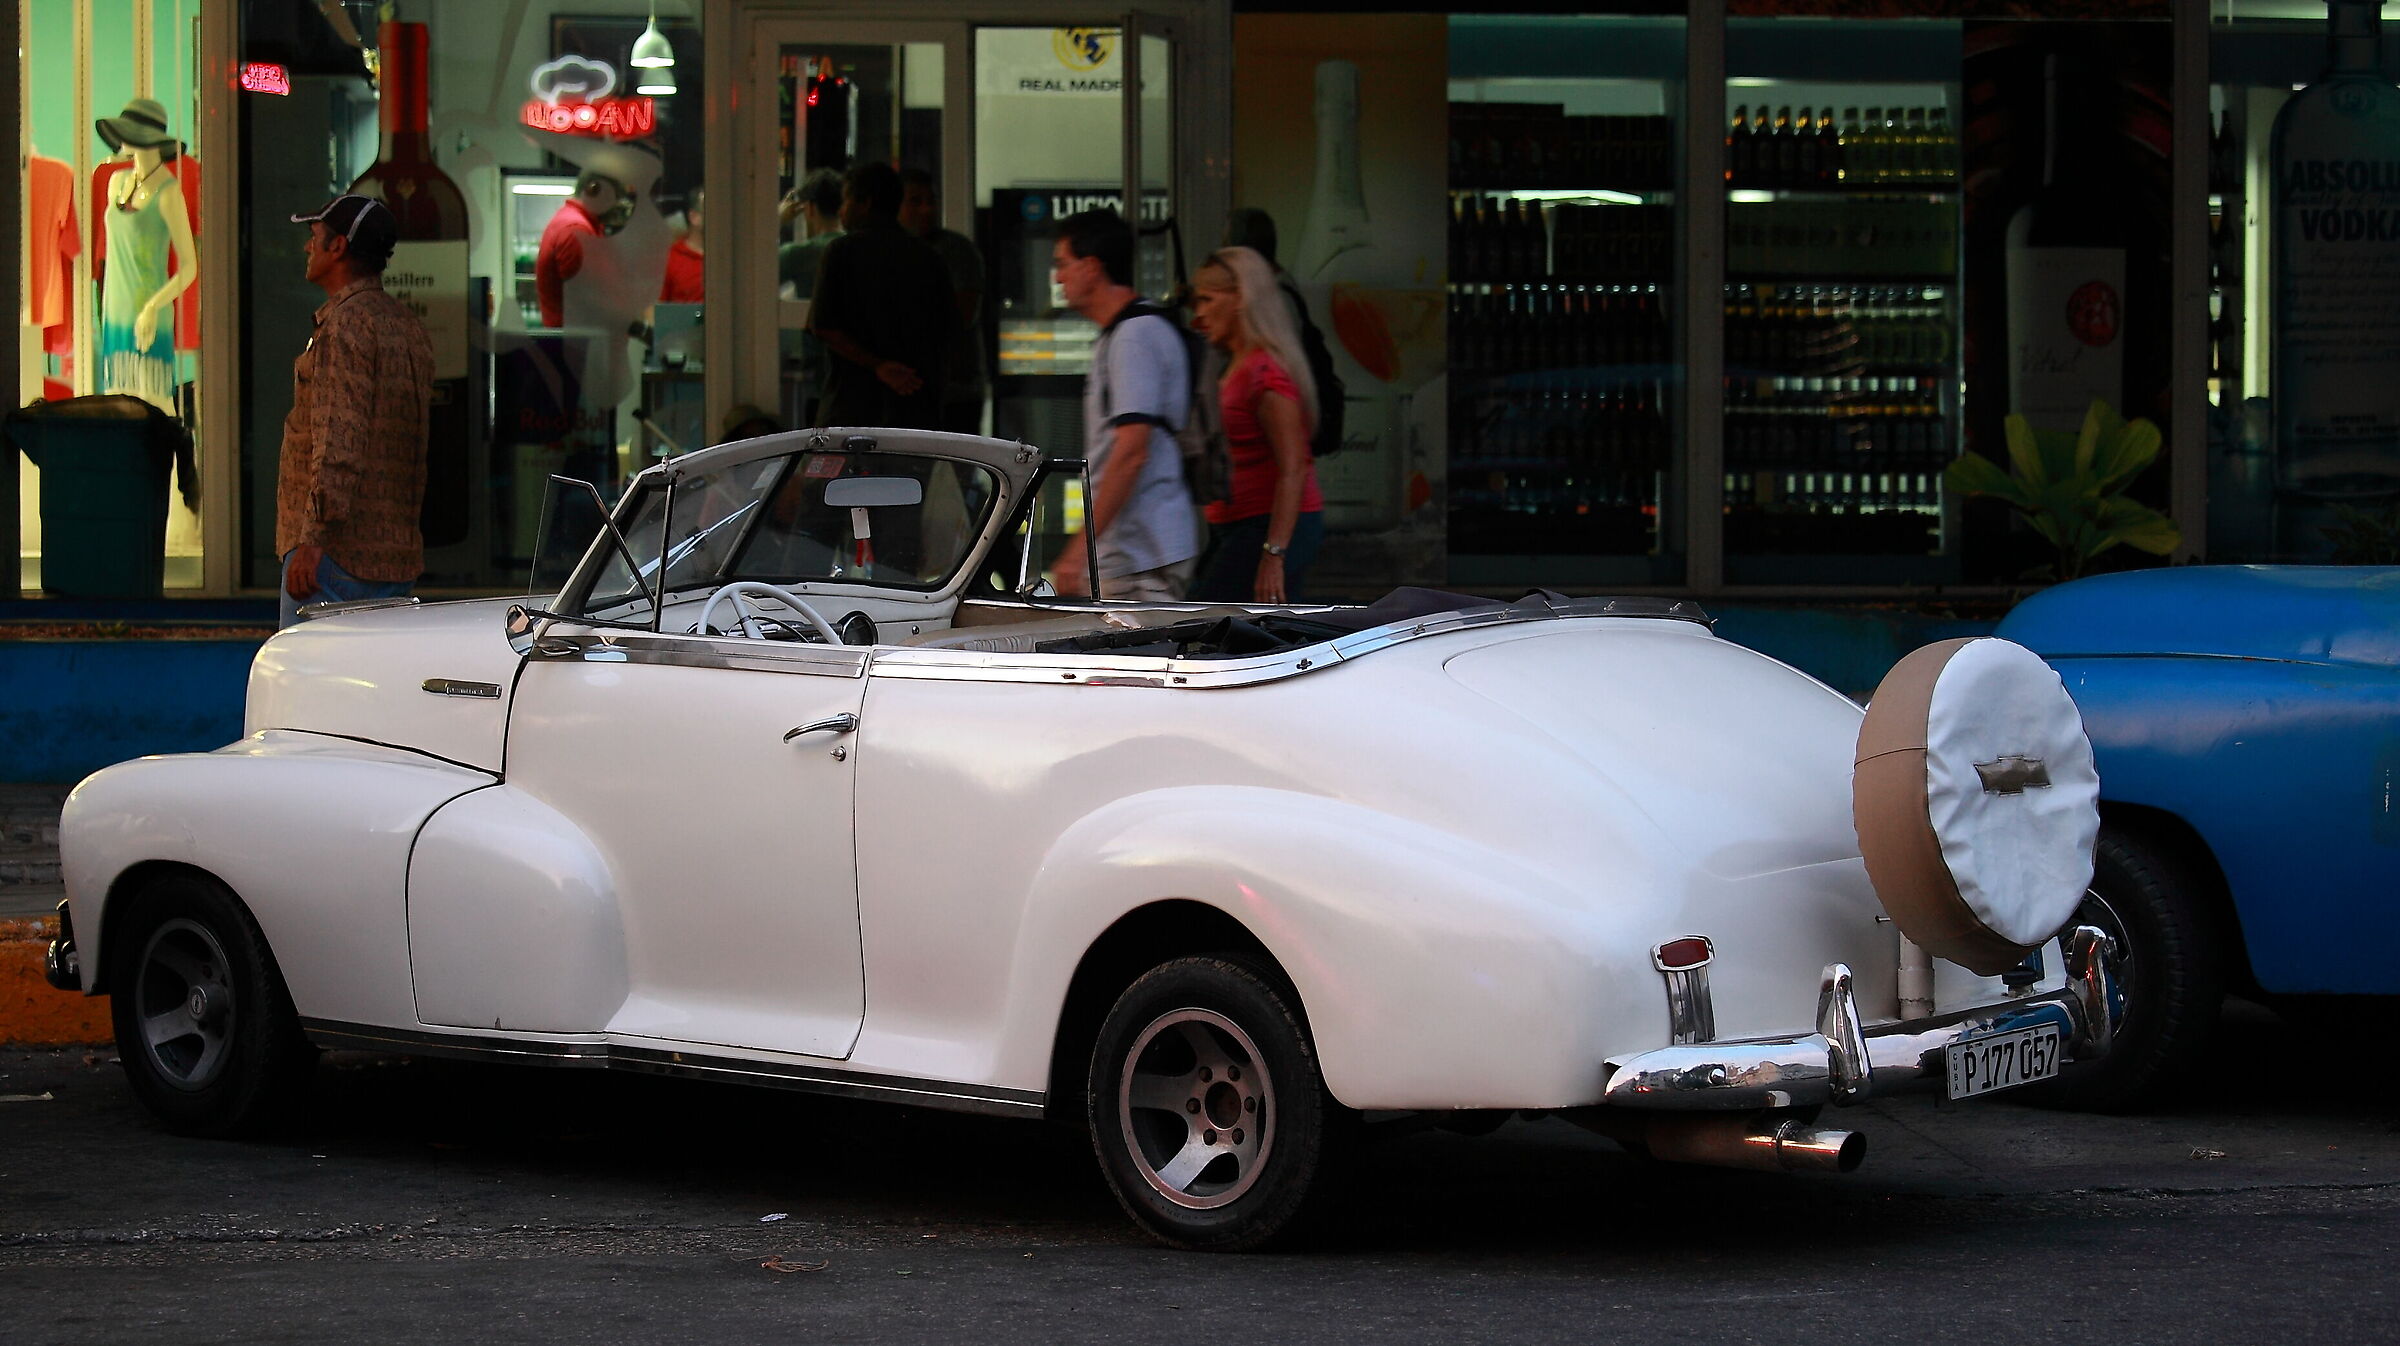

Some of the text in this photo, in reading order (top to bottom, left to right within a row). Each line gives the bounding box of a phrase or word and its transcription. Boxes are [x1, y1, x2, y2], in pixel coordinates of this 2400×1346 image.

[1020, 79, 1144, 92] REAL MADR
[2302, 208, 2400, 241] VODKA
[383, 273, 434, 287] asillero
